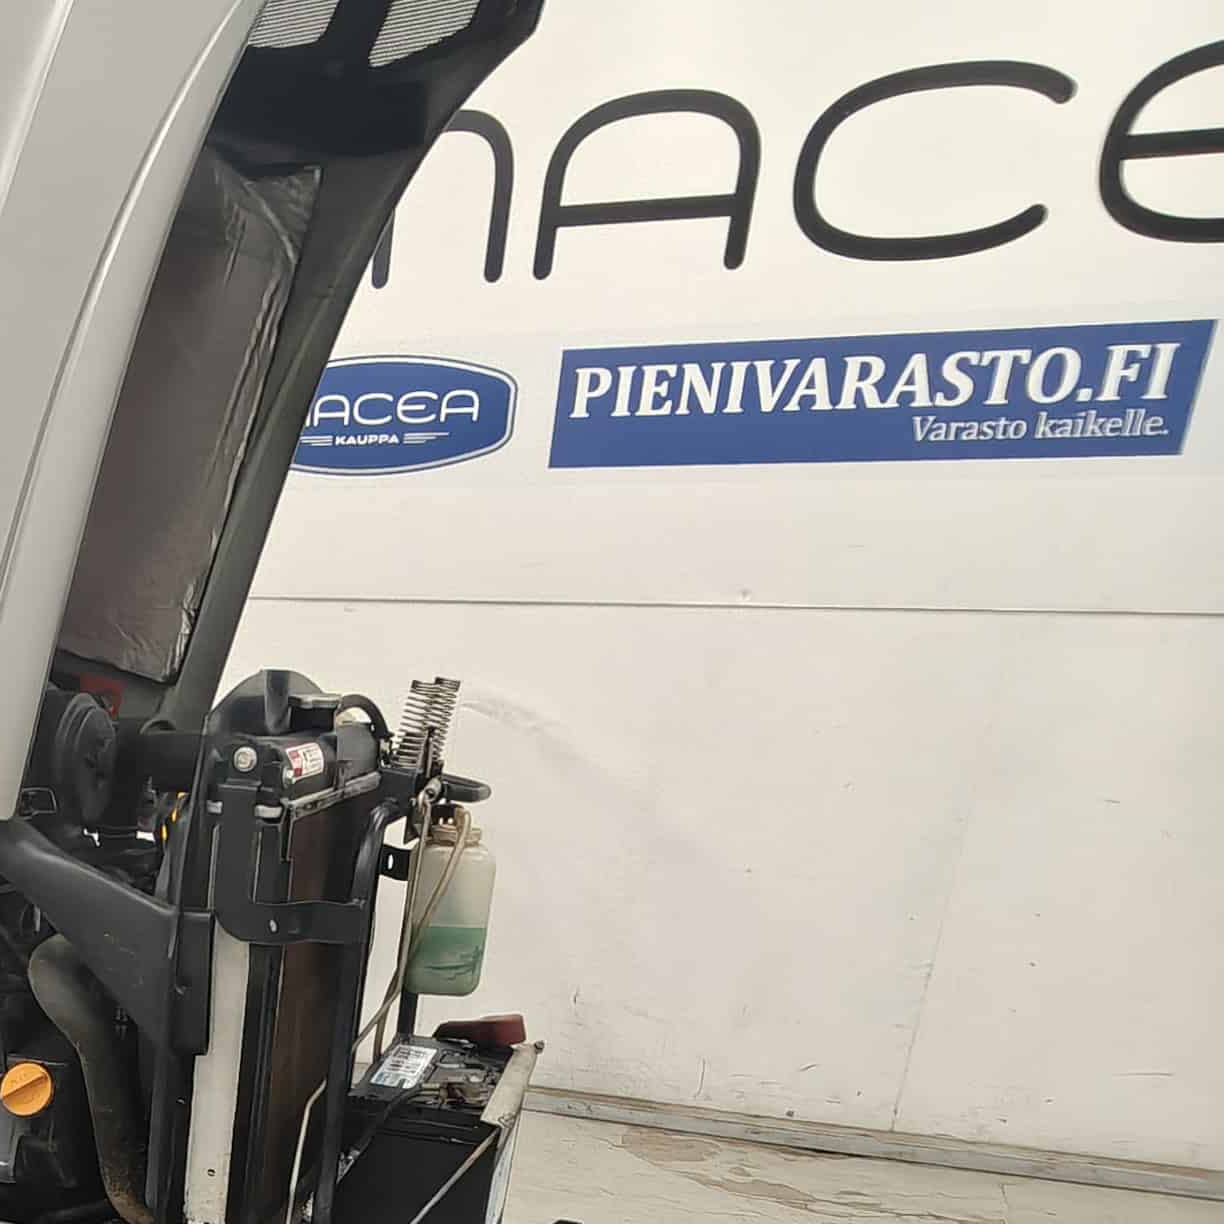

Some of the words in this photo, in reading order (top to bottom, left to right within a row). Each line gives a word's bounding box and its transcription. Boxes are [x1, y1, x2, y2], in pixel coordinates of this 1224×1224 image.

[569, 343, 1181, 419] PIENIVARASTO.FI
[305, 389, 480, 427] ACEA
[912, 414, 1027, 442] Varasto
[1034, 408, 1169, 440] kaikelle.
[335, 434, 400, 446] KAUPPA
